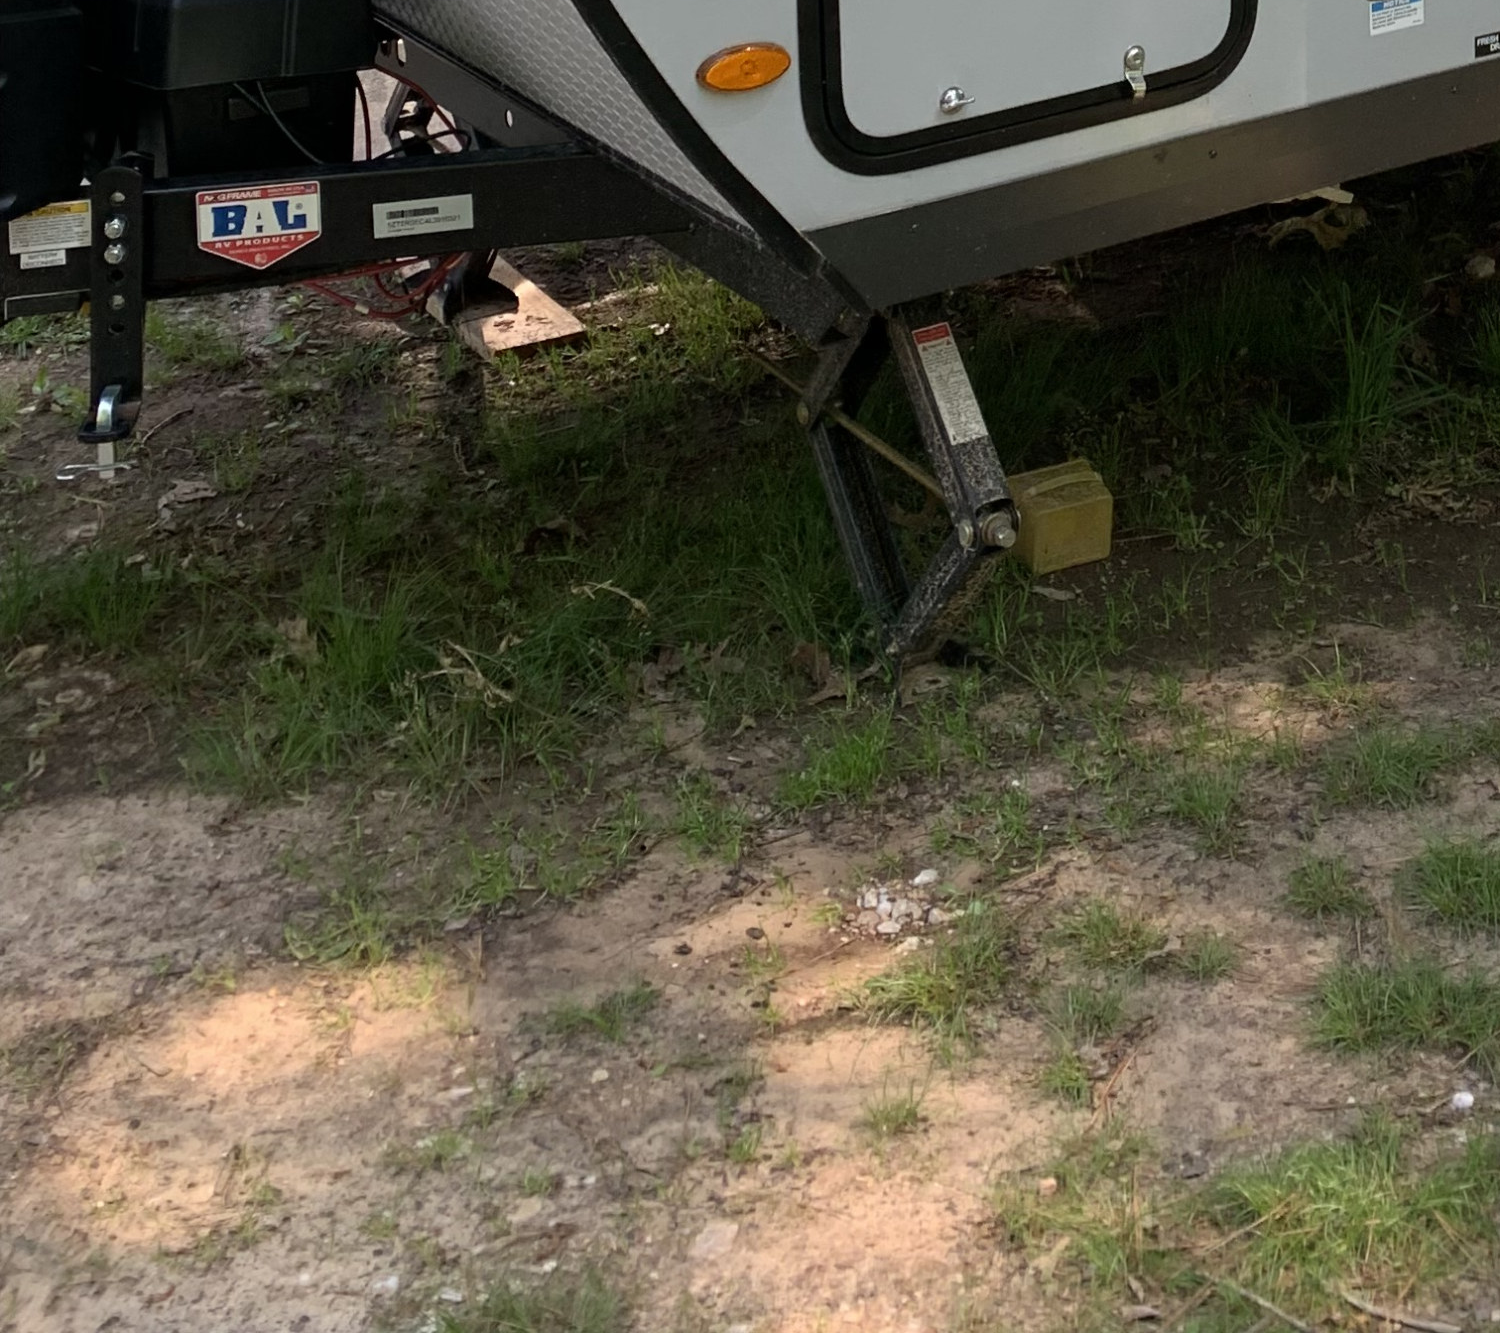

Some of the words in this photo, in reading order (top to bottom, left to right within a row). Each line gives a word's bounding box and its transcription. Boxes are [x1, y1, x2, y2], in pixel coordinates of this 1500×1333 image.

[1477, 33, 1499, 47] FRESH
[211, 200, 307, 237] BAL
[215, 239, 232, 249] RV
[236, 234, 305, 247] PRODUCTS
